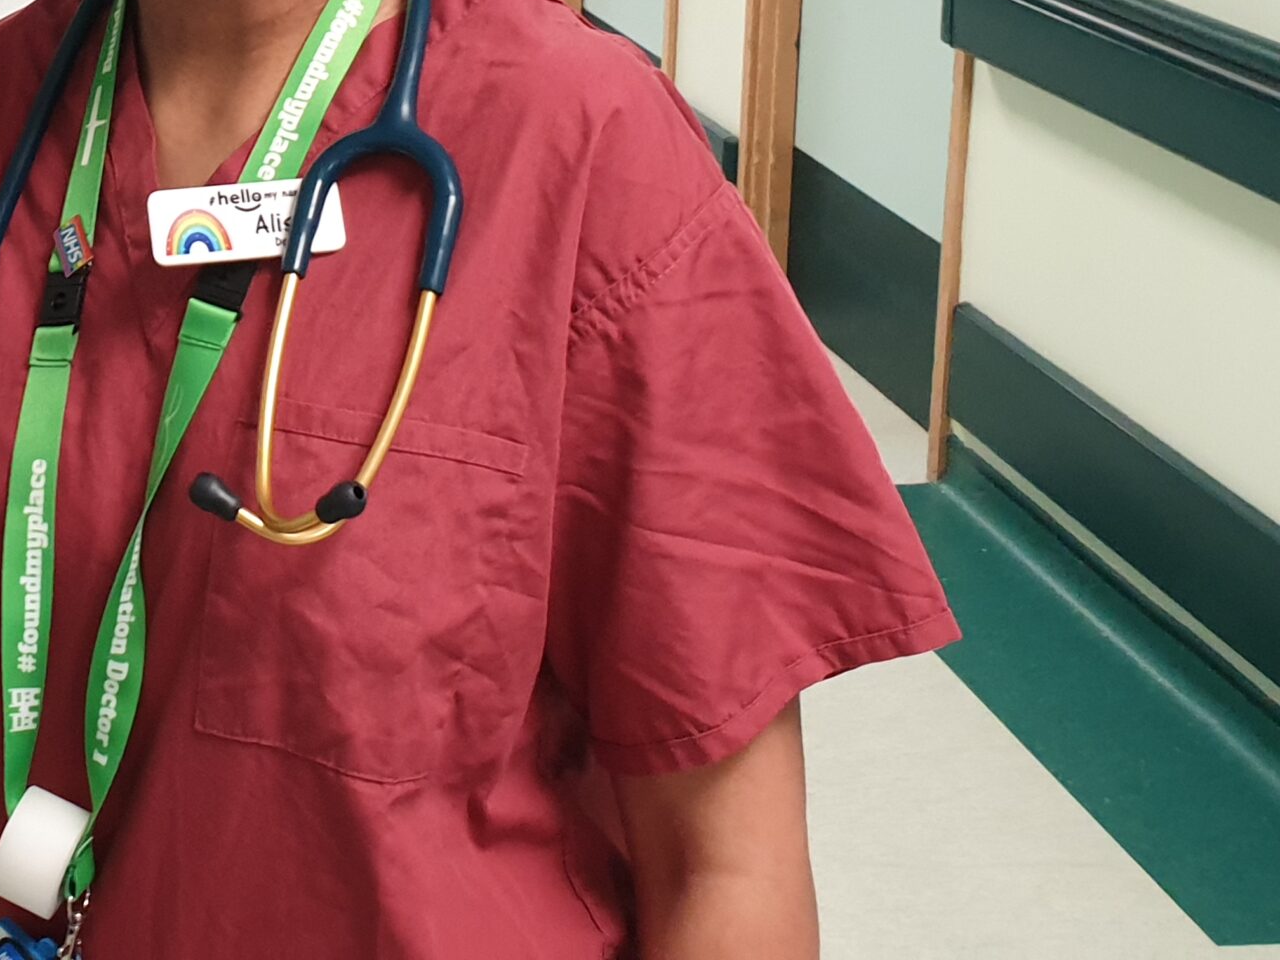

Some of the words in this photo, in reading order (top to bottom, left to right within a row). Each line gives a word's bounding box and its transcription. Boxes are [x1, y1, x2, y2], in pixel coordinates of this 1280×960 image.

[60, 226, 83, 264] NHS
[17, 458, 49, 673] #foundmyplace
[96, 659, 129, 748] Doctor
